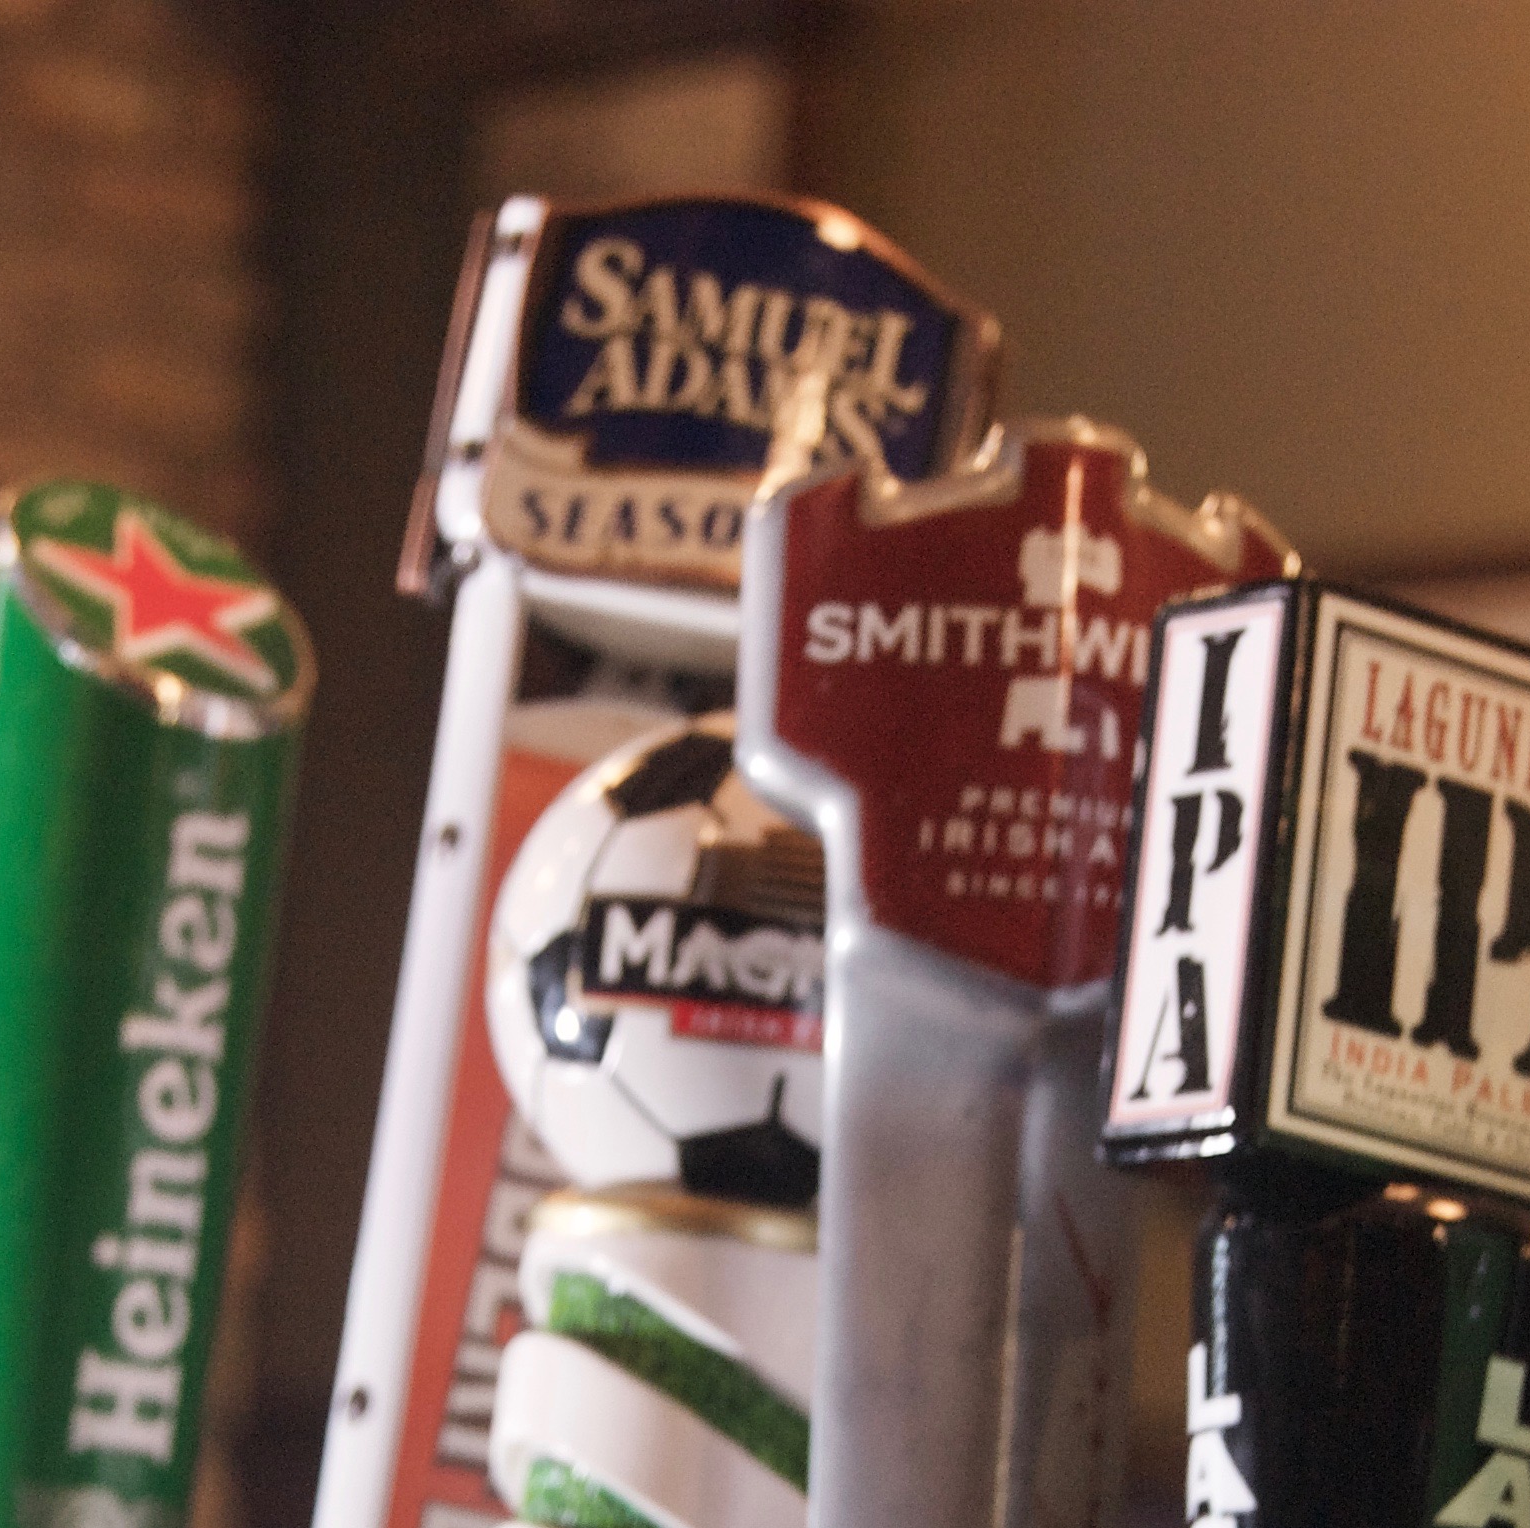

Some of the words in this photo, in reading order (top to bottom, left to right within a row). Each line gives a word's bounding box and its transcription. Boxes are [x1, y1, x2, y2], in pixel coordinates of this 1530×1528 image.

[562, 235, 927, 415] SAMUEL
[522, 488, 746, 548] SEASO
[805, 600, 1151, 690] SMITHWI
[1127, 628, 1249, 1102] IPA
[599, 903, 826, 999] MAGN
[1328, 1033, 1430, 1085] INDIA
[69, 811, 252, 1463] Heineken
